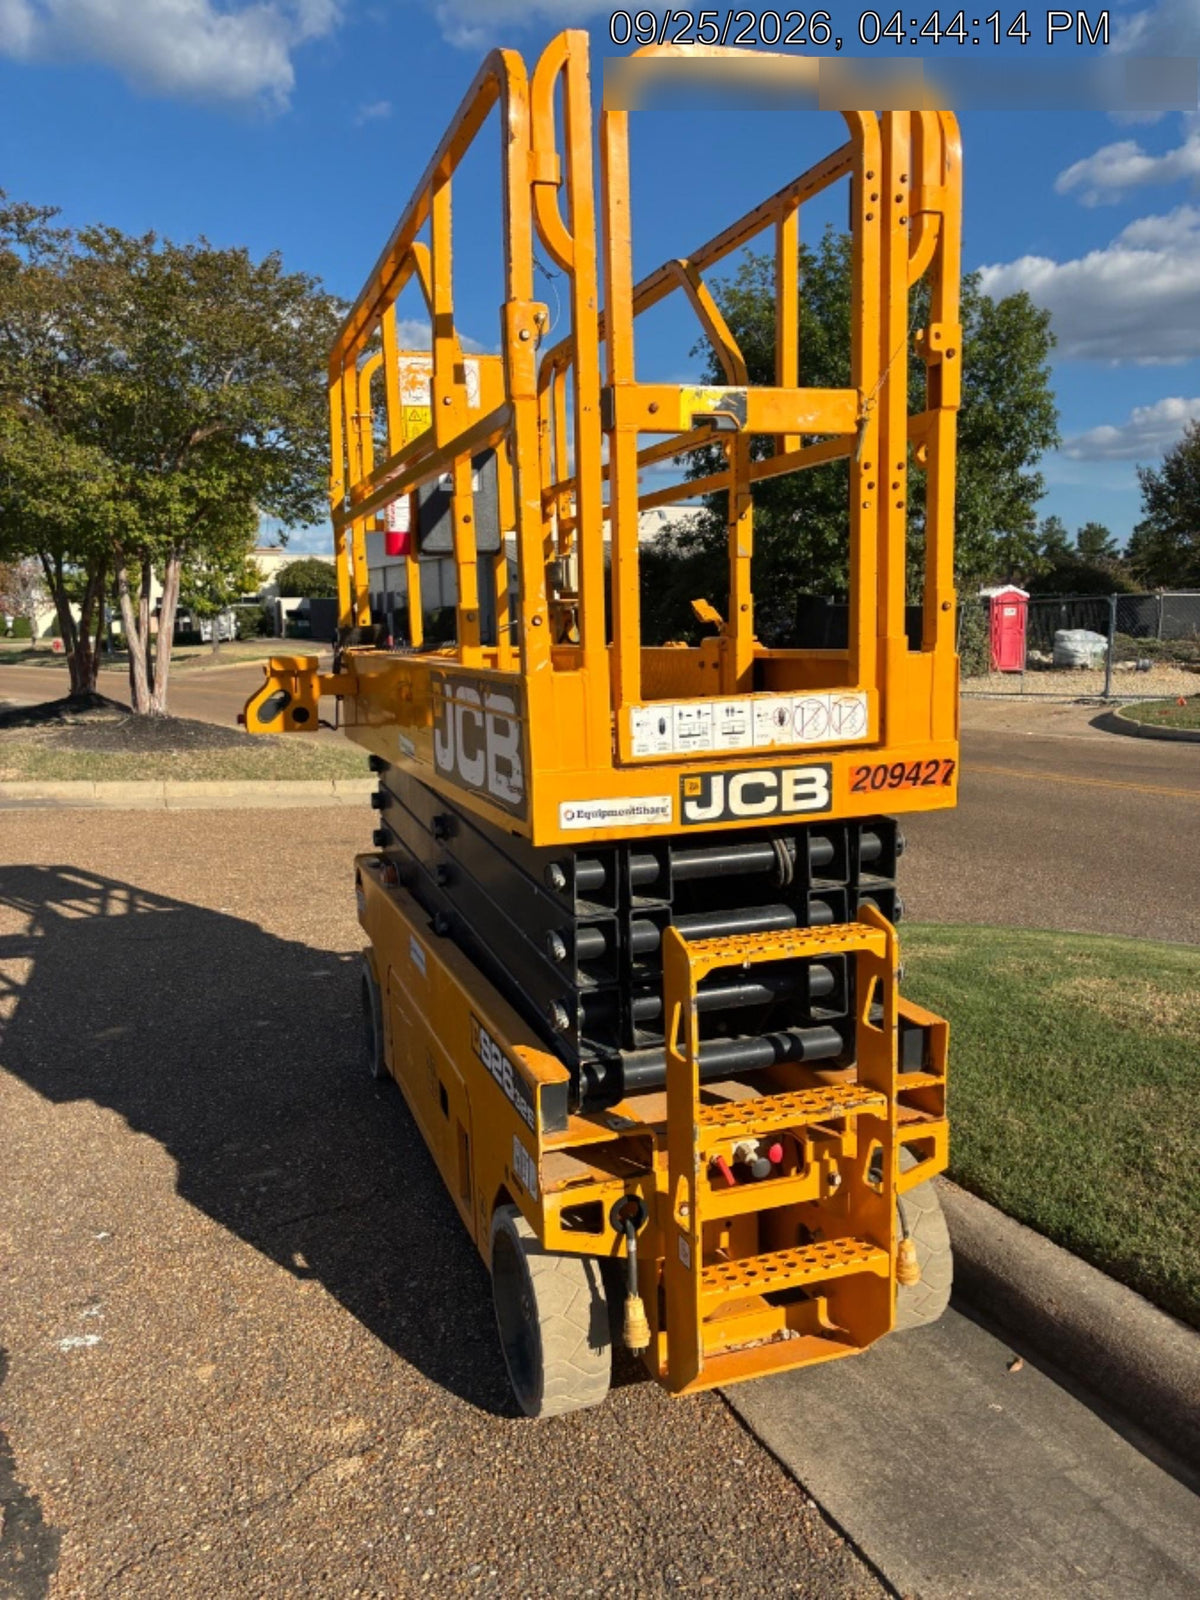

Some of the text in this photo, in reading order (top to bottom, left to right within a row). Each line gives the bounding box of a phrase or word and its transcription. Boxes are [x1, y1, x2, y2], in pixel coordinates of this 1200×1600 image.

[434, 683, 524, 804] JCB
[684, 767, 830, 821] JCB
[850, 758, 956, 792] 209427
[576, 804, 669, 820] EquipmentShare
